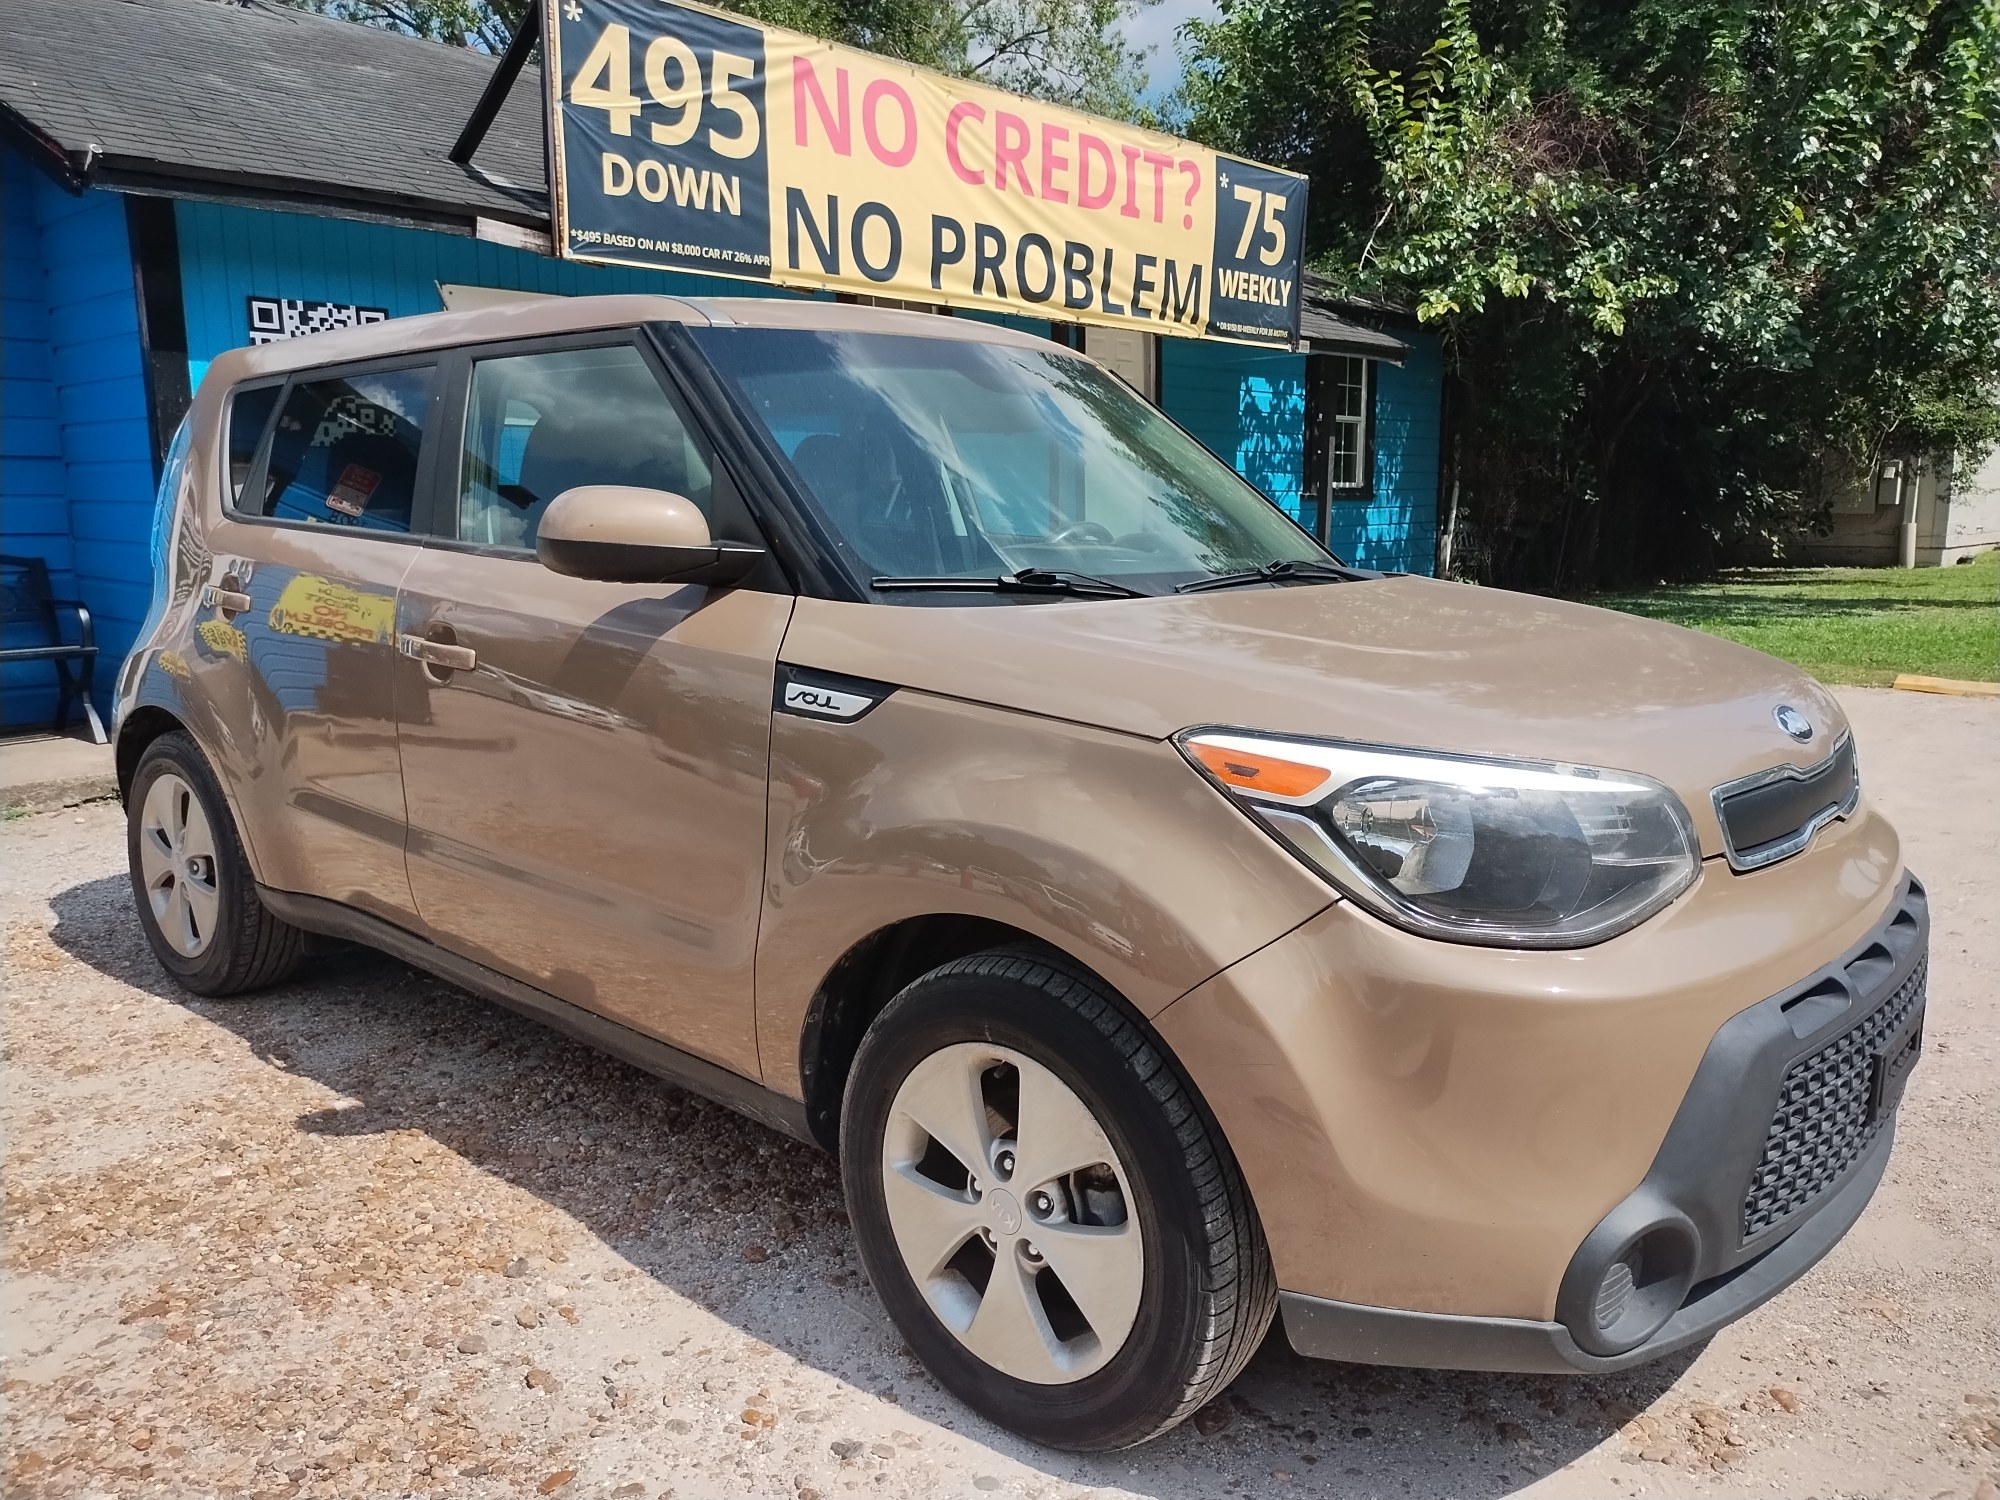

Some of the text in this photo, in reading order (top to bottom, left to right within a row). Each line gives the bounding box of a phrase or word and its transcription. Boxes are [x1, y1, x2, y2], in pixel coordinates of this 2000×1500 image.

[792, 54, 1201, 231] NO CREDIT?
[602, 152, 742, 217] DOWN
[603, 232, 636, 248] BASED
[637, 237, 654, 251] ON
[655, 241, 670, 253] AN
[671, 243, 701, 258] $8,000
[702, 247, 720, 260] CAR
[721, 250, 733, 261] AT
[734, 251, 752, 264] 26%
[753, 254, 771, 267] APR
[786, 186, 1203, 326] NO PROBLEM
[1218, 267, 1292, 308] WEEKLY
